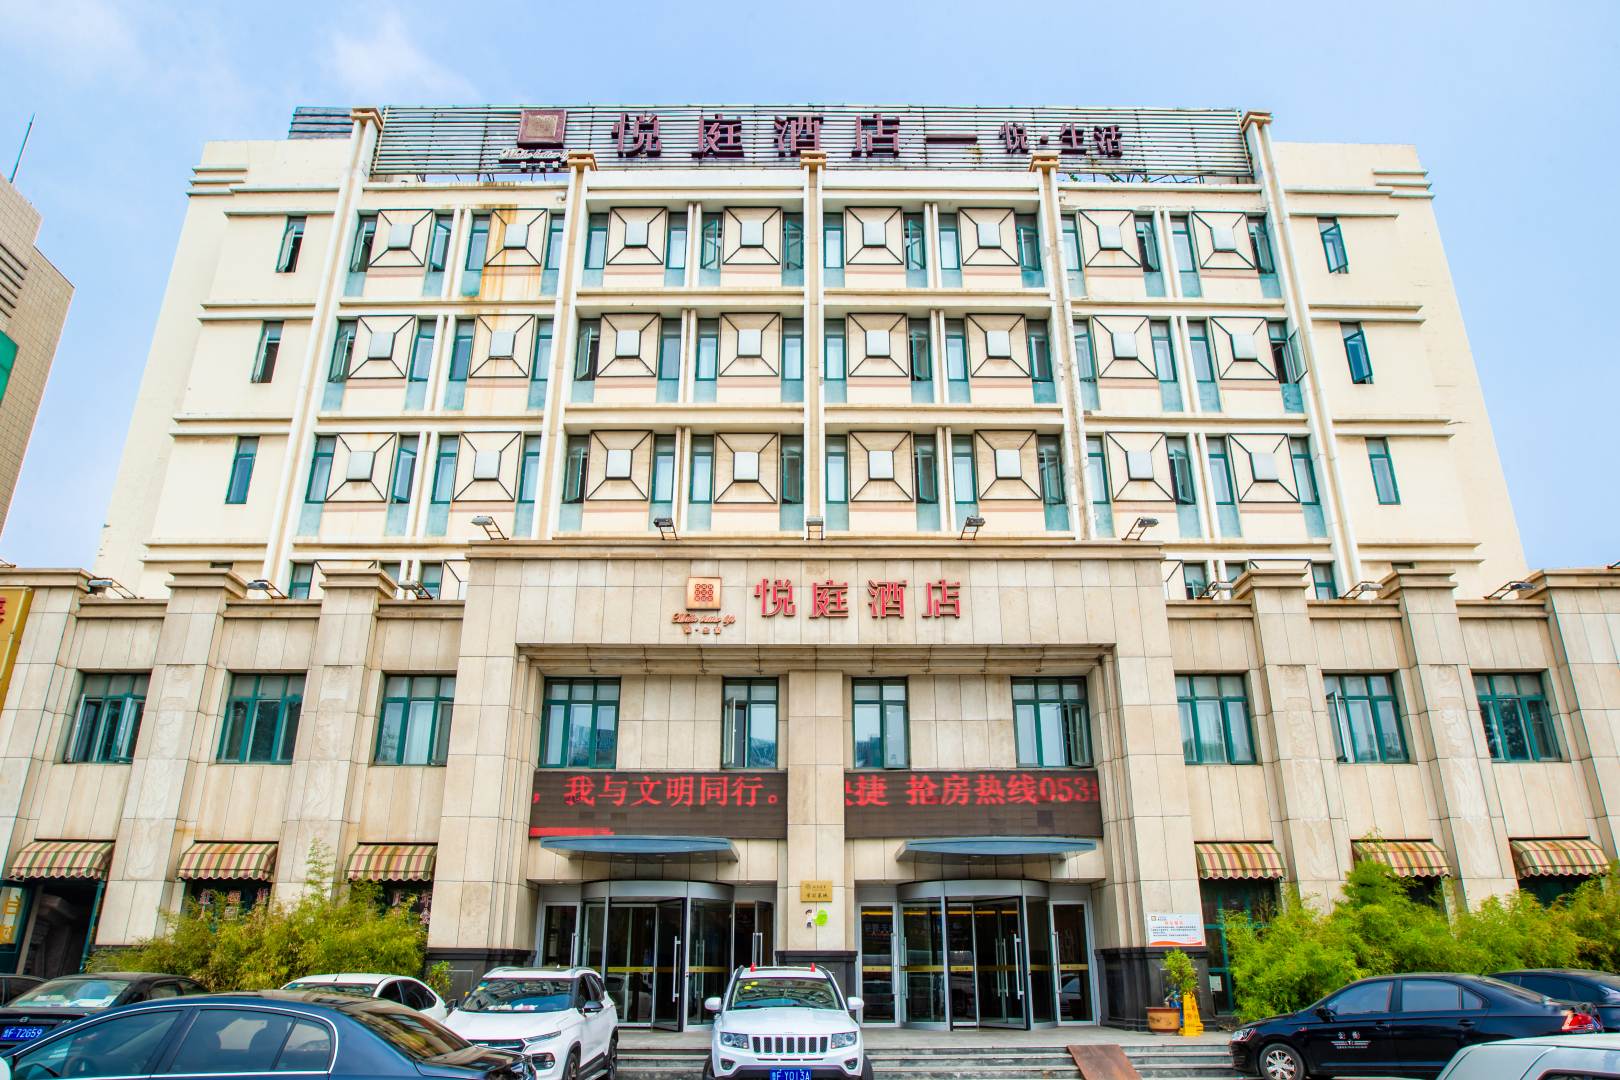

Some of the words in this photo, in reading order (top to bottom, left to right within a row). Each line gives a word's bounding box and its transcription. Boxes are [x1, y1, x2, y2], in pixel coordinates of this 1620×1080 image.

[612, 113, 901, 158] 悦庭酒店
[754, 577, 960, 619] 悦庭酒店
